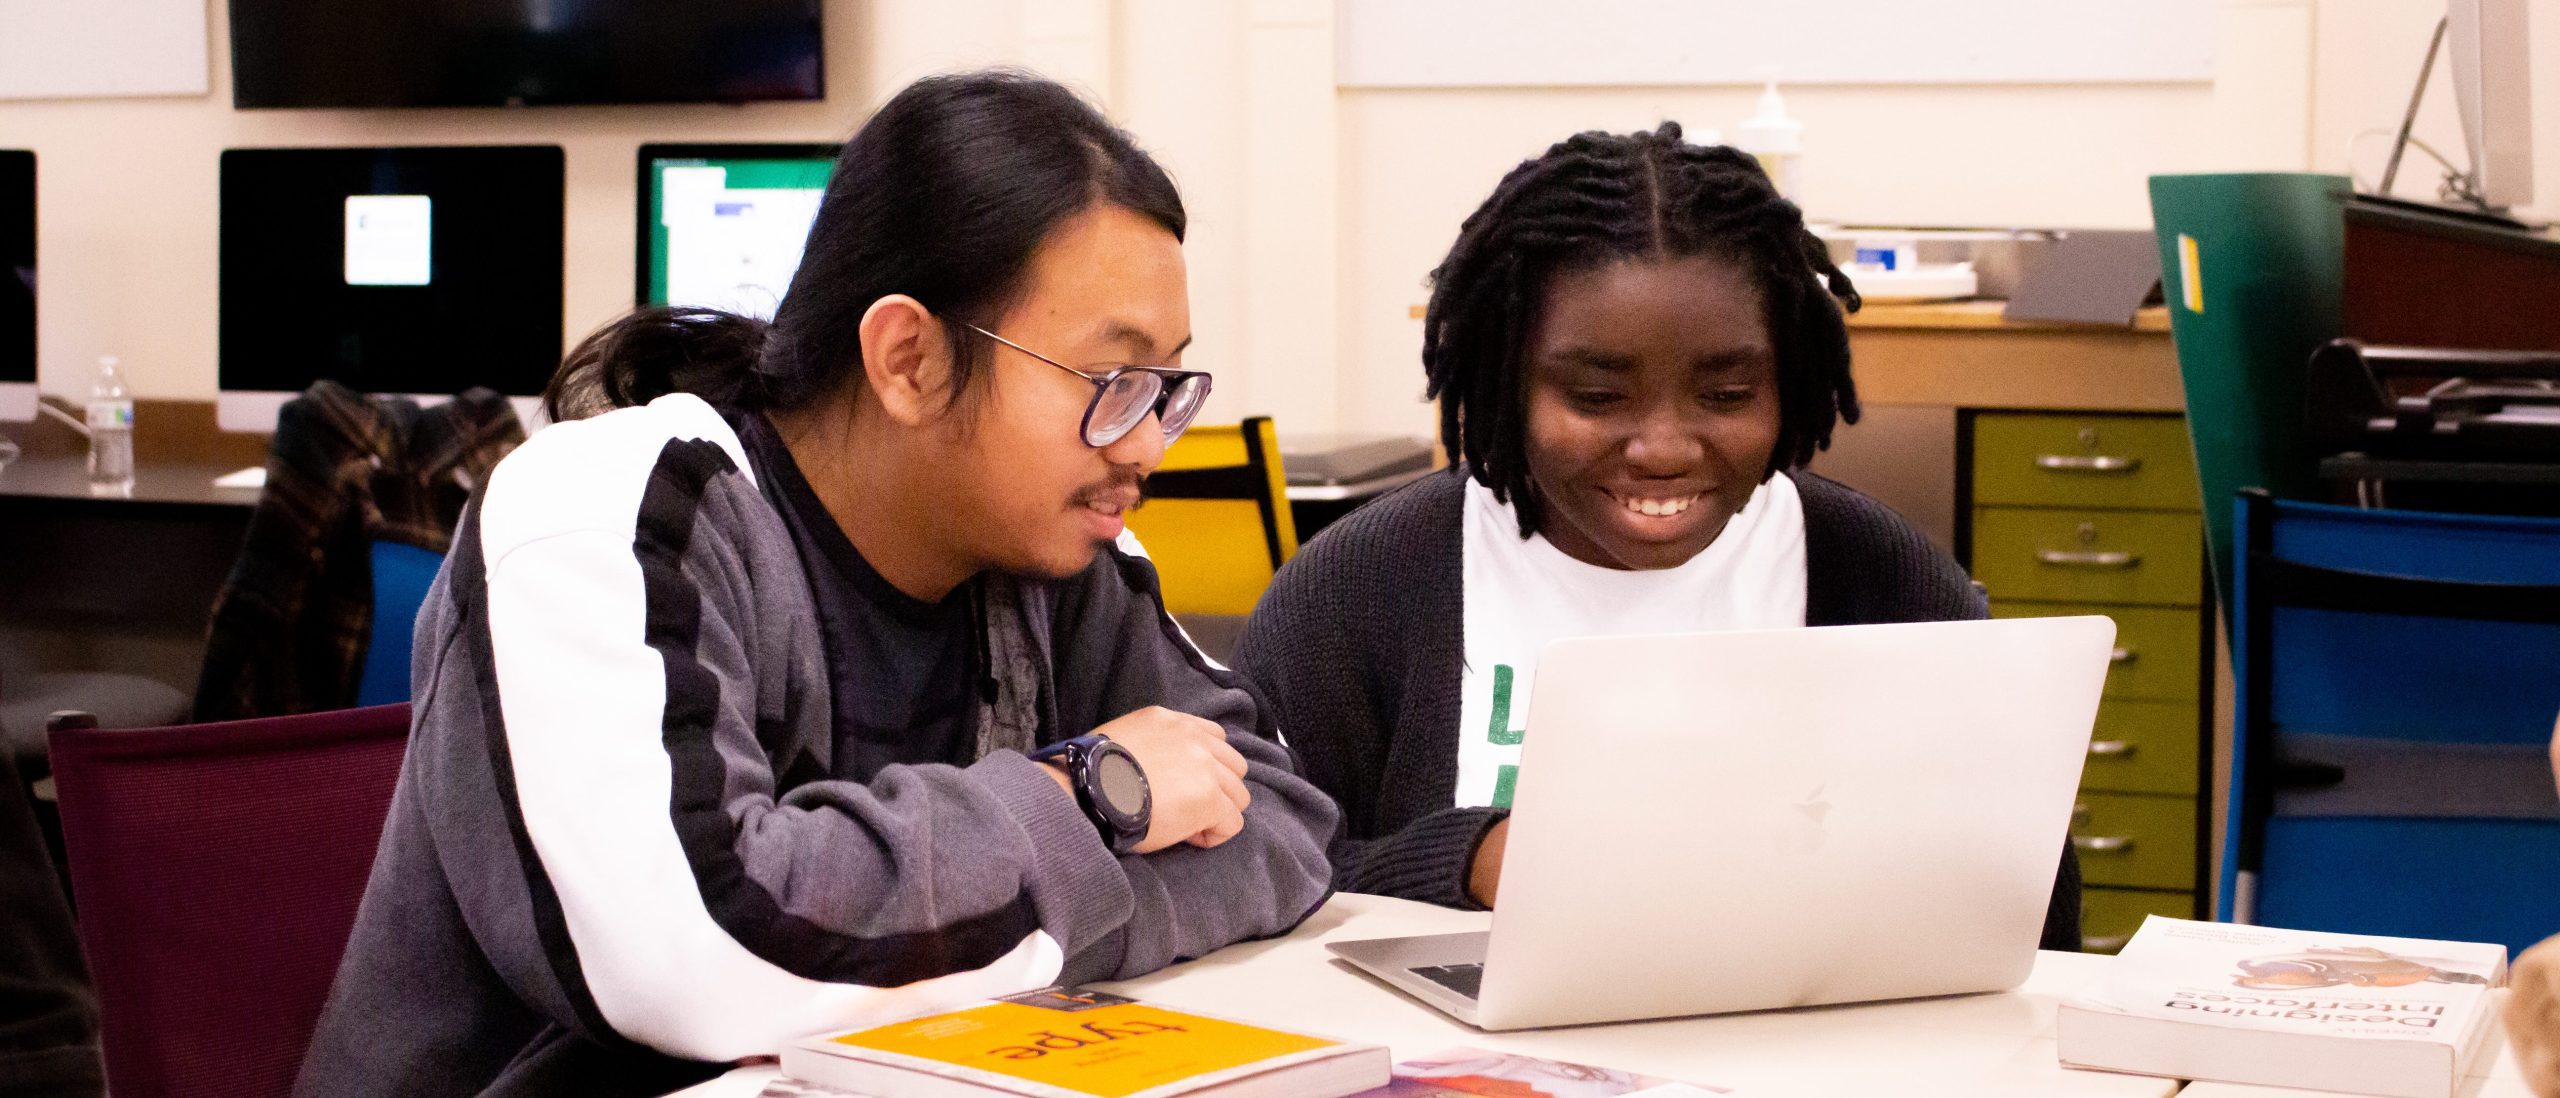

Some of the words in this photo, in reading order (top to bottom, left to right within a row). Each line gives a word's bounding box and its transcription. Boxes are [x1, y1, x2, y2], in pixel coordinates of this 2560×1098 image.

[2164, 1000, 2438, 1028] Designing
[2174, 991, 2445, 1016] Interfaces
[986, 1021, 1189, 1060] type
